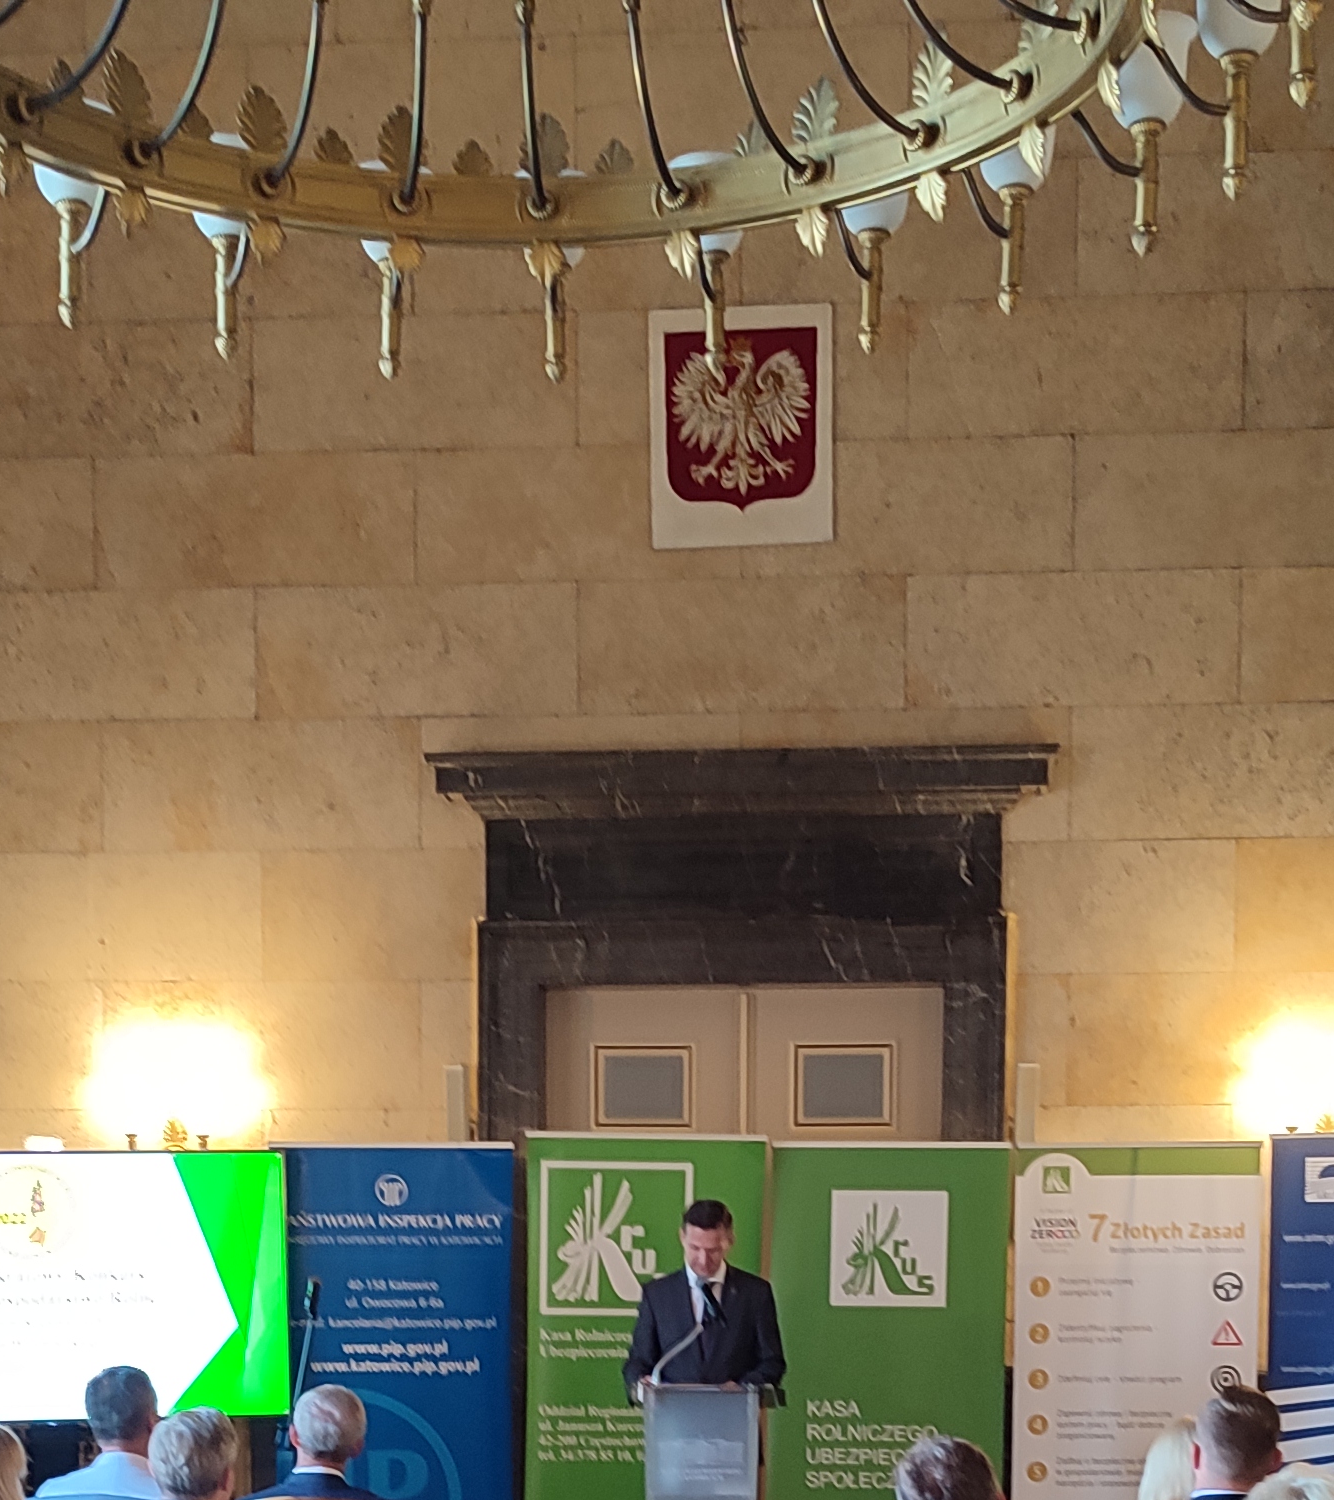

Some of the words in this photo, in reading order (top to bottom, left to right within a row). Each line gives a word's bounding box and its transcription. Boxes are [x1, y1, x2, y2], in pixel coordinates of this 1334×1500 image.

[455, 1213, 503, 1229] PRACY
[1087, 1213, 1108, 1243] 7
[1109, 1221, 1183, 1243] Złotych
[1188, 1221, 1246, 1241] Zasad
[552, 1172, 665, 1303] Kru
[341, 1336, 449, 1358] www.pip.gov.pl
[309, 1355, 481, 1377] www.katowice.pip.gov.pl
[805, 1400, 861, 1418] KASA
[805, 1447, 908, 1466] UBEZPIEC
[804, 1471, 896, 1490] SPOŁECZ
